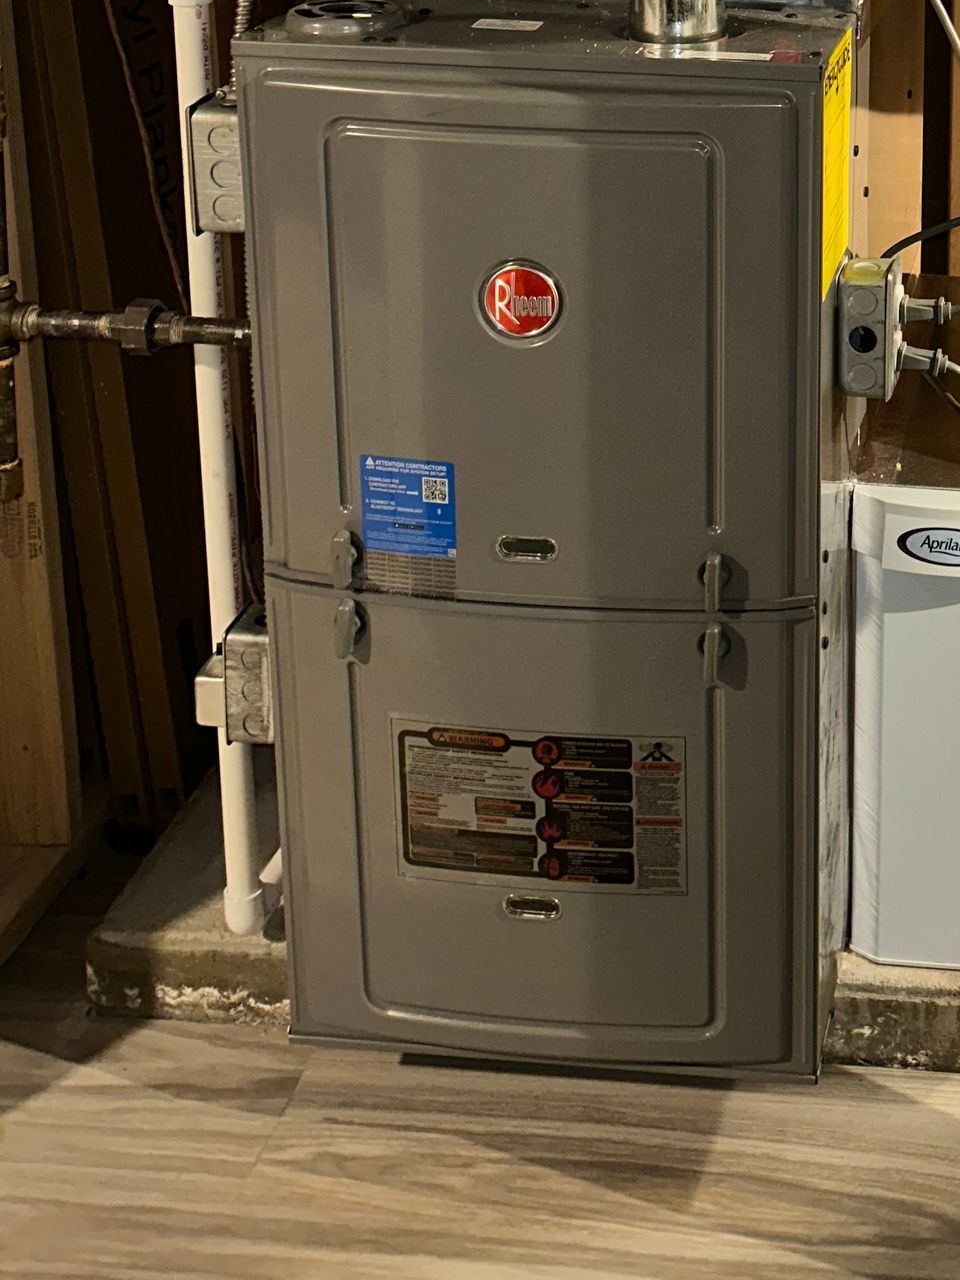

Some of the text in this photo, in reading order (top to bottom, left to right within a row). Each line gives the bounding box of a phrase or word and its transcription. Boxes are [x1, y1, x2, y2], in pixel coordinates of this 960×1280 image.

[494, 272, 553, 325] Rheem
[375, 460, 447, 471] ATTENTION CONTRACTORS
[449, 734, 495, 747] WARNING
